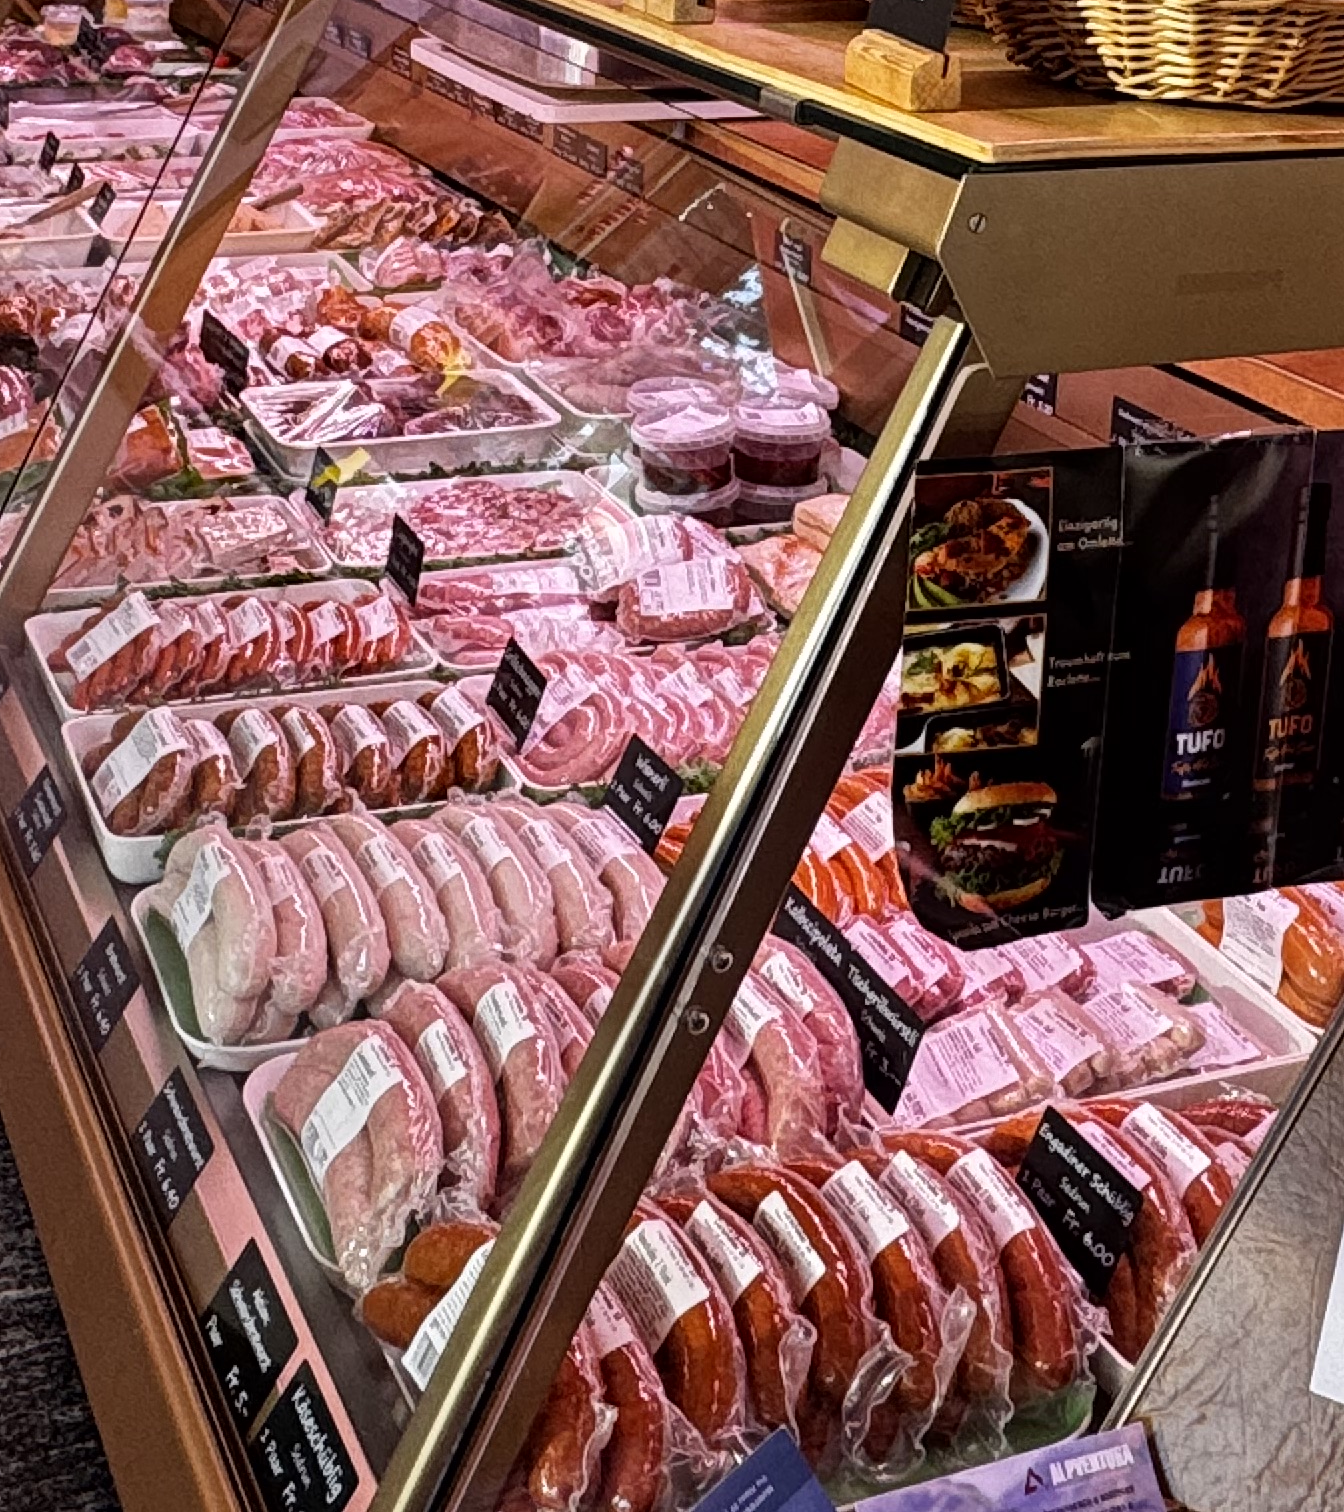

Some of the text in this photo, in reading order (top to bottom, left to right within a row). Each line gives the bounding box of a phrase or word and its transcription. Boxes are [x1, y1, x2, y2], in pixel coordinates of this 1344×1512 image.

[1176, 728, 1226, 756] TUFO
[1268, 714, 1314, 739] TUFO
[1039, 1122, 1092, 1178] Engadiner
[1031, 1177, 1056, 1208] Paar
[1082, 1231, 1115, 1267] 6.00
